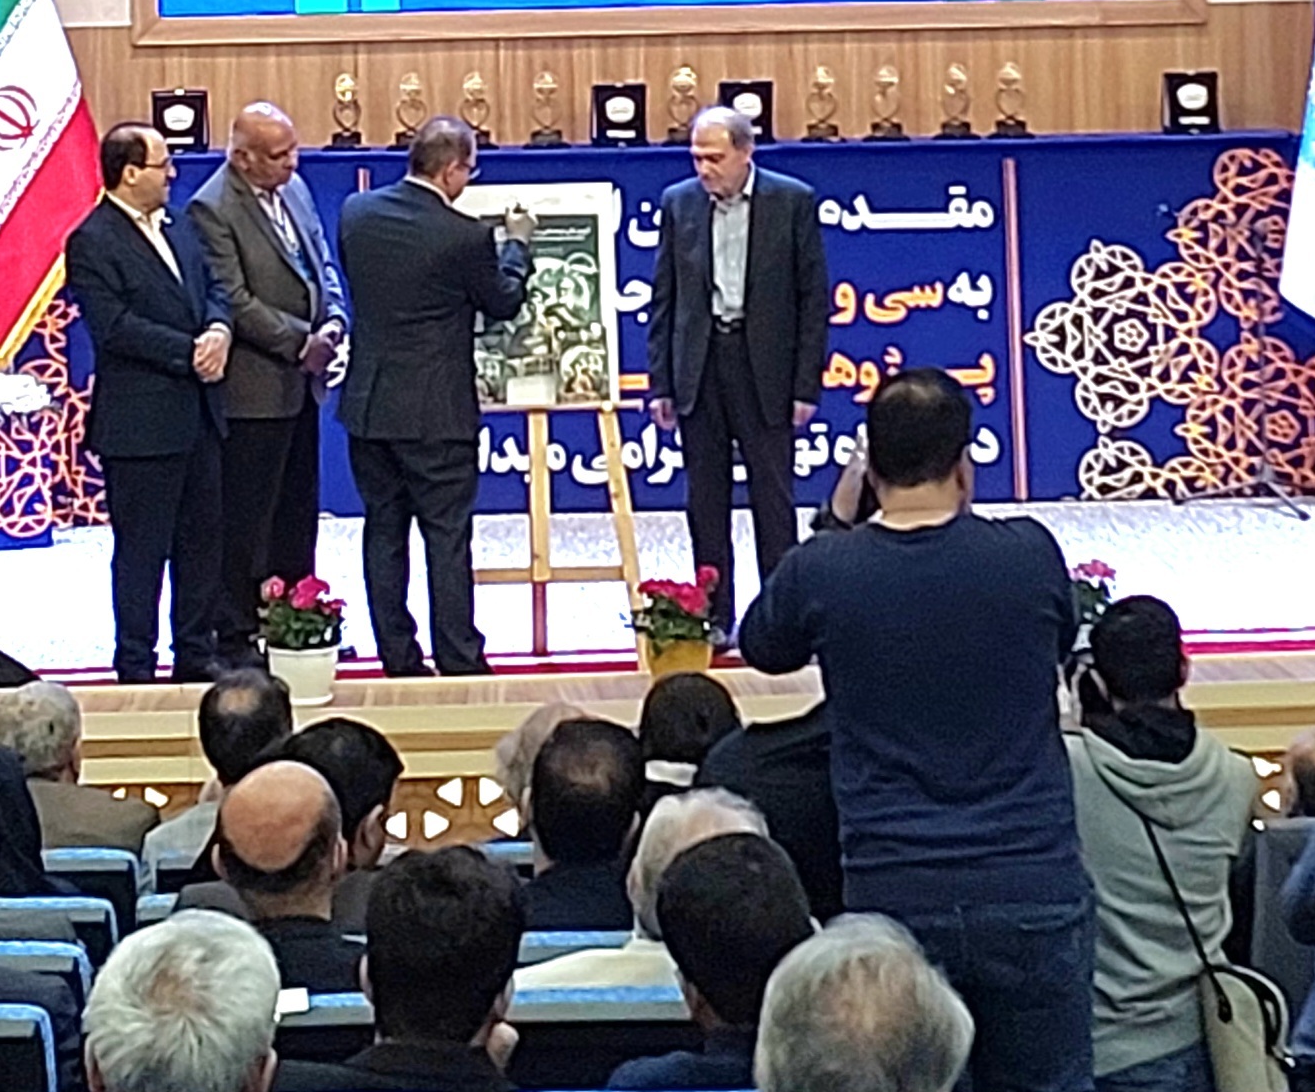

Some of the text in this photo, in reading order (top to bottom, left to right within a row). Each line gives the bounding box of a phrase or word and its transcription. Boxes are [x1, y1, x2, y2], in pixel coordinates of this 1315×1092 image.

[829, 271, 993, 324] به سی و
